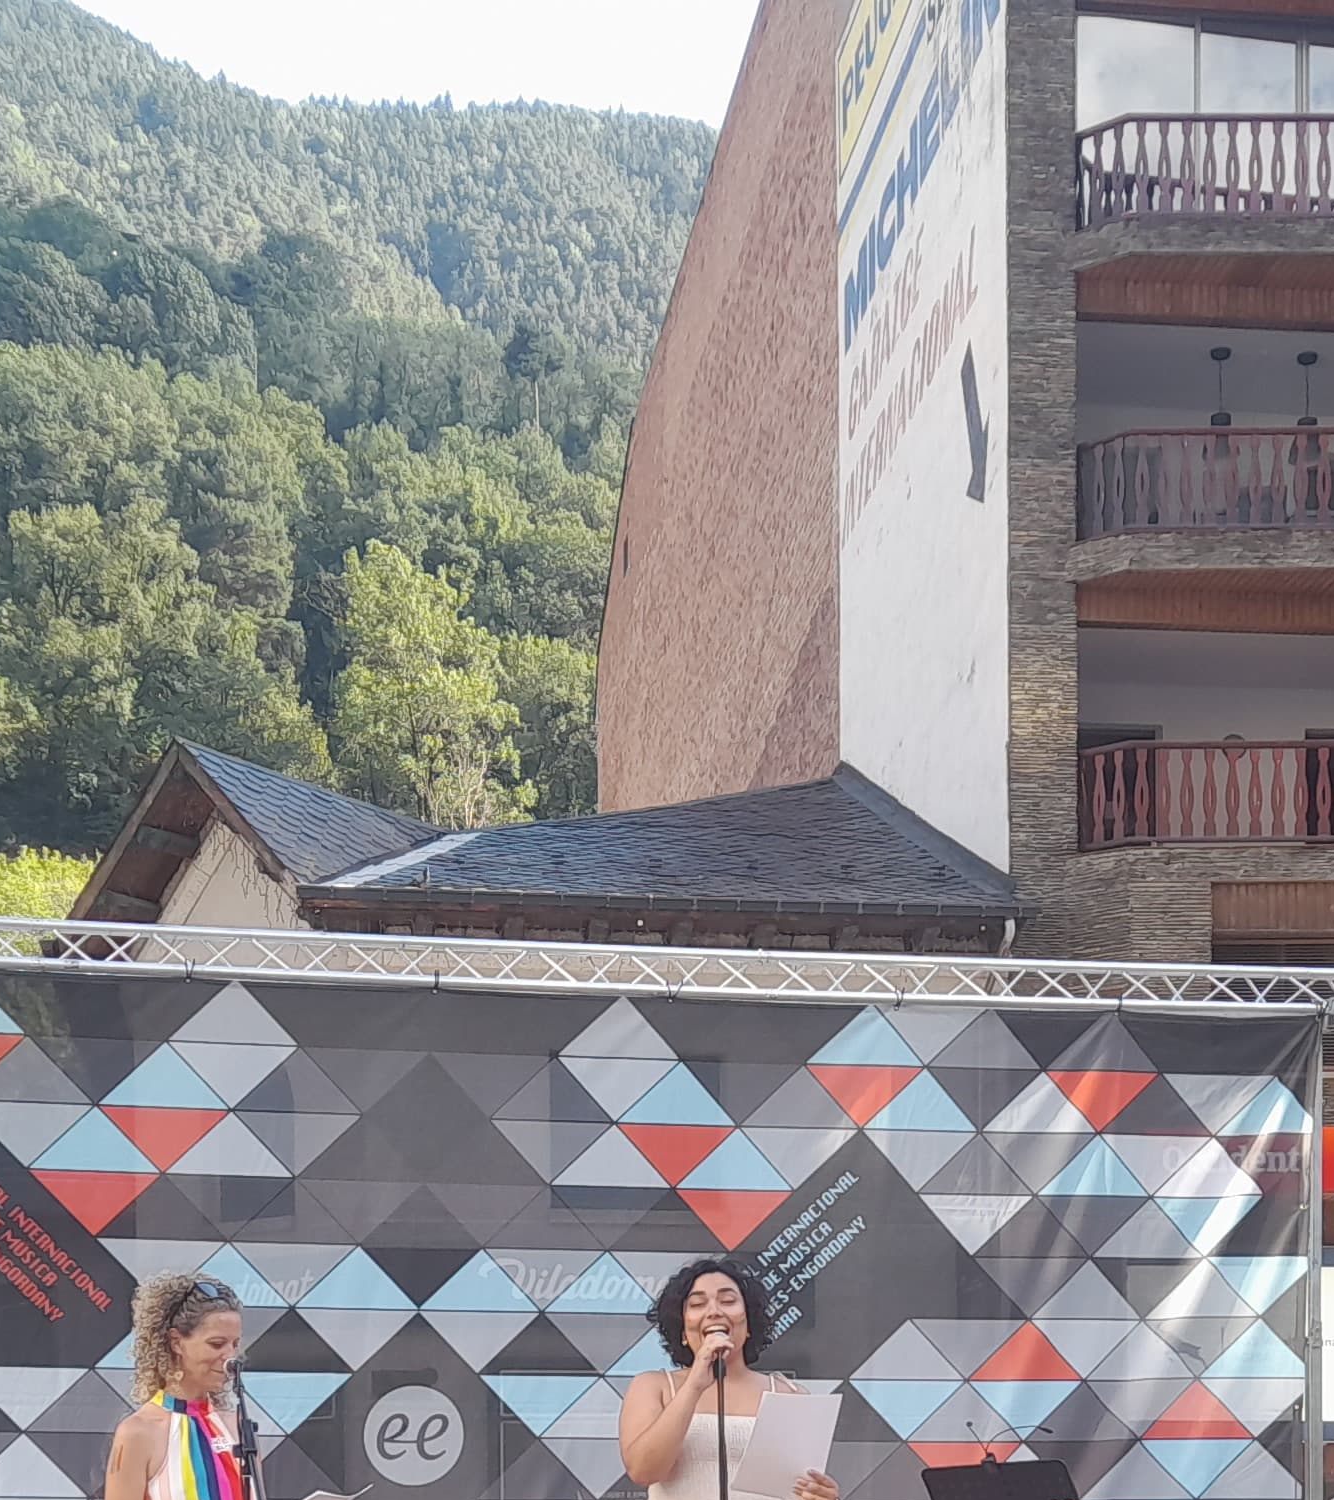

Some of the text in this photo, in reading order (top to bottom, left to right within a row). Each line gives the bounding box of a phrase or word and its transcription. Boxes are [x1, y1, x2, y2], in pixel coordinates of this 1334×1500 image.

[845, 0, 1000, 356] MICHELIN
[842, 225, 978, 549] INTERNACIONAL
[7, 1205, 114, 1313] INTERNACIONAL
[757, 1170, 860, 1268] INTERNACIONAL
[376, 1410, 449, 1461] ee
